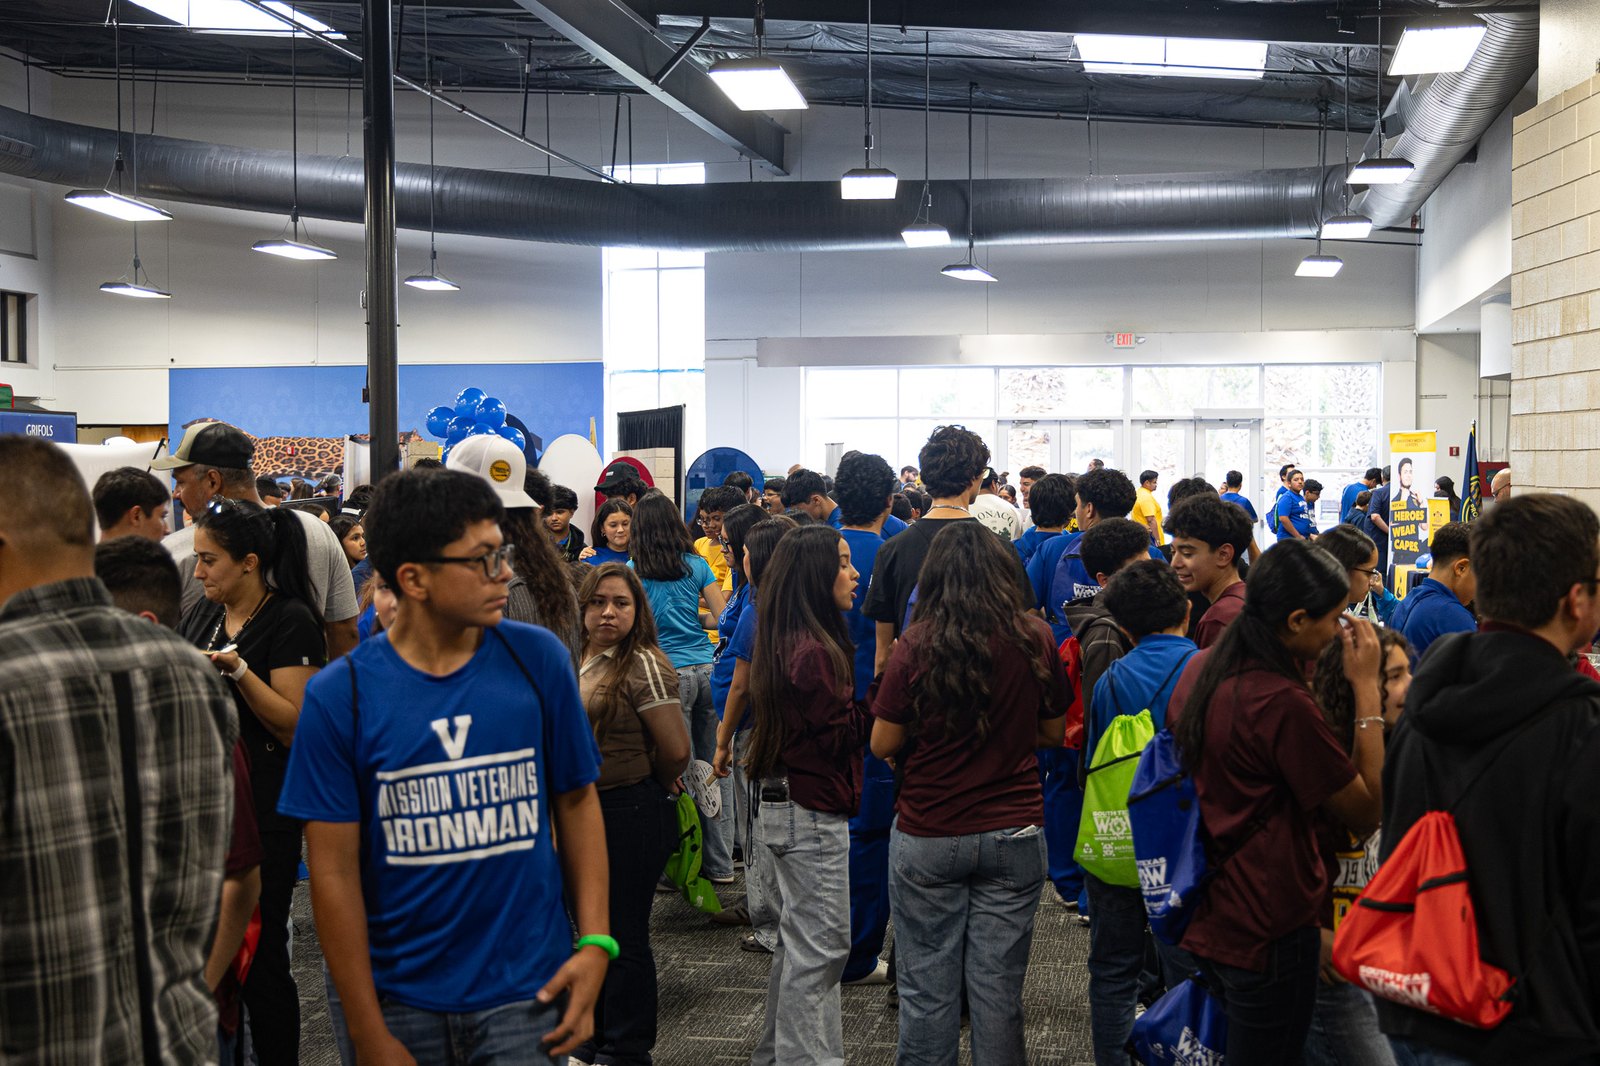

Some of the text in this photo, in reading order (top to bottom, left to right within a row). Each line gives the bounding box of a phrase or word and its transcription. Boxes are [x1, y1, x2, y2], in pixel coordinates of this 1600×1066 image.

[1116, 332, 1133, 346] EXIT
[26, 424, 54, 437] GRIFOLS
[977, 510, 1013, 526] ONACO
[1394, 510, 1425, 521] HEROES
[1392, 524, 1416, 538] WEAR
[430, 714, 472, 760] V
[378, 760, 538, 817] MISSION VETERANS
[382, 799, 539, 853] IRONMAN
